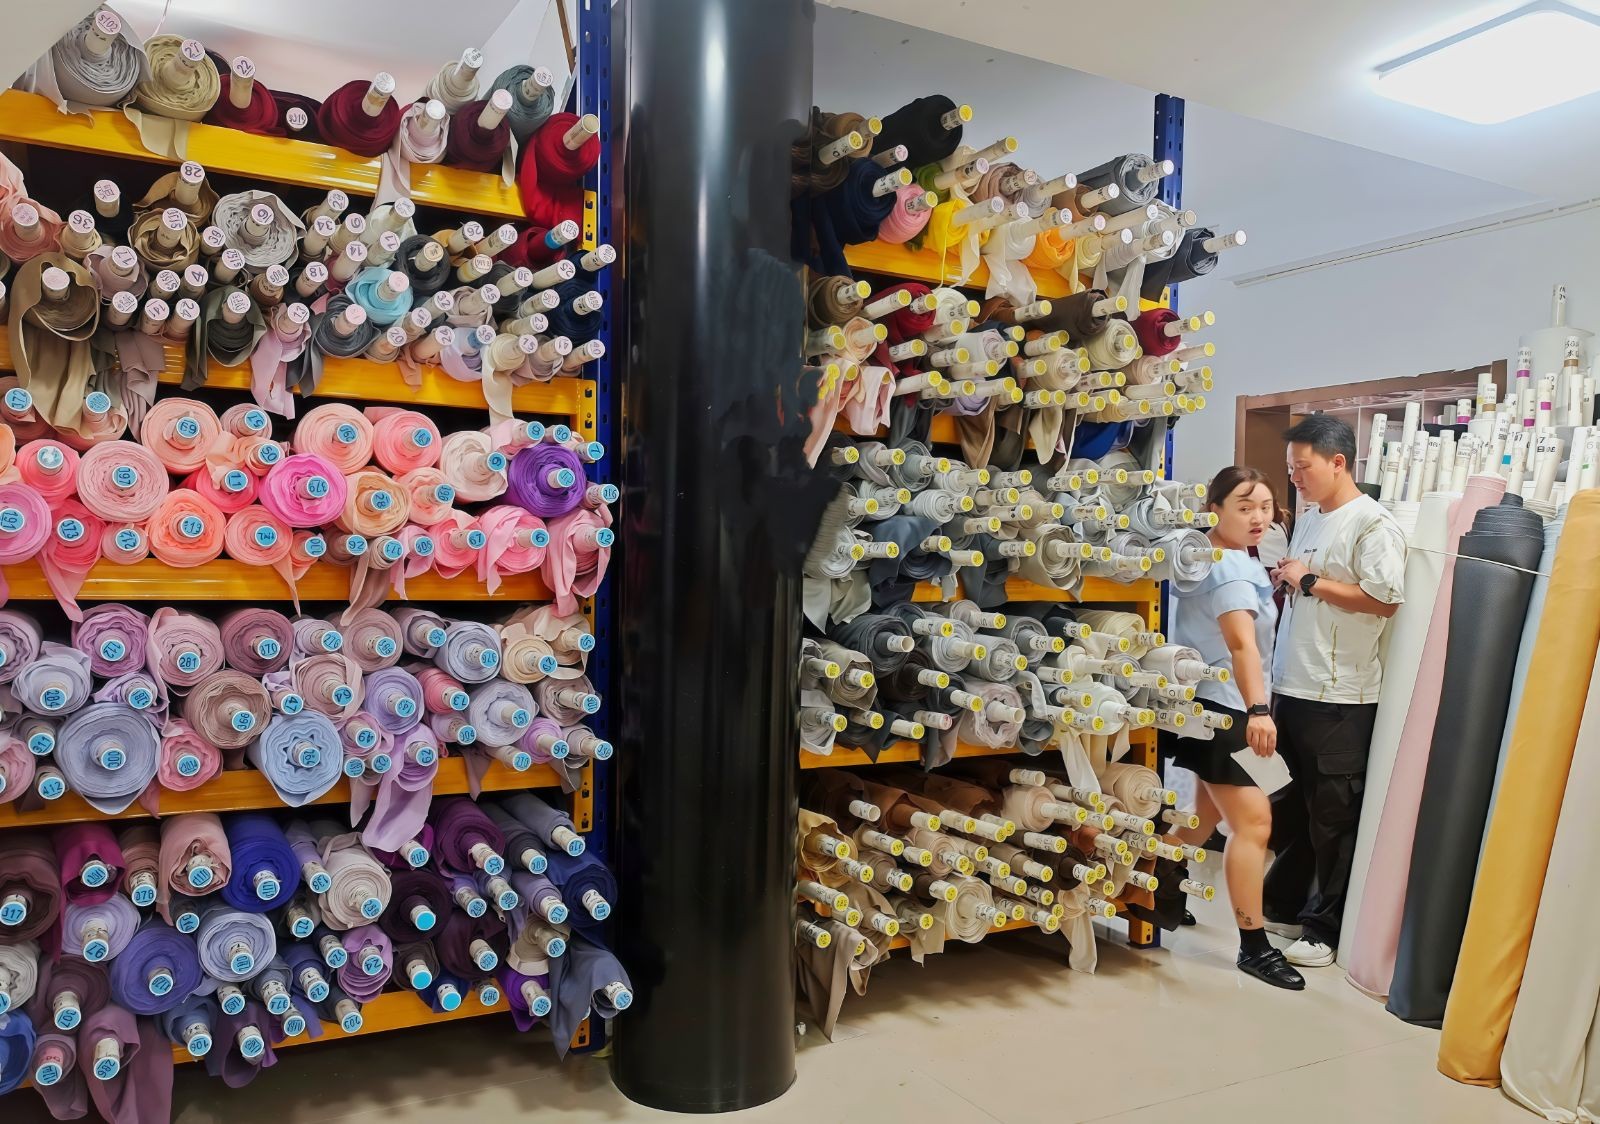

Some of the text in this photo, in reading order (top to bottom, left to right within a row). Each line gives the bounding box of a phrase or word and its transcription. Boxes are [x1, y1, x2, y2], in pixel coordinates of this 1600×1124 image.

[237, 60, 251, 75] 22
[73, 214, 91, 229] 36
[317, 221, 333, 231] 34
[467, 225, 482, 237] 26
[350, 244, 362, 256] 14
[309, 265, 324, 277] 18
[261, 446, 277, 462] 50
[119, 469, 131, 485] 197
[5, 512, 18, 529] 191
[180, 657, 196, 668] 281
